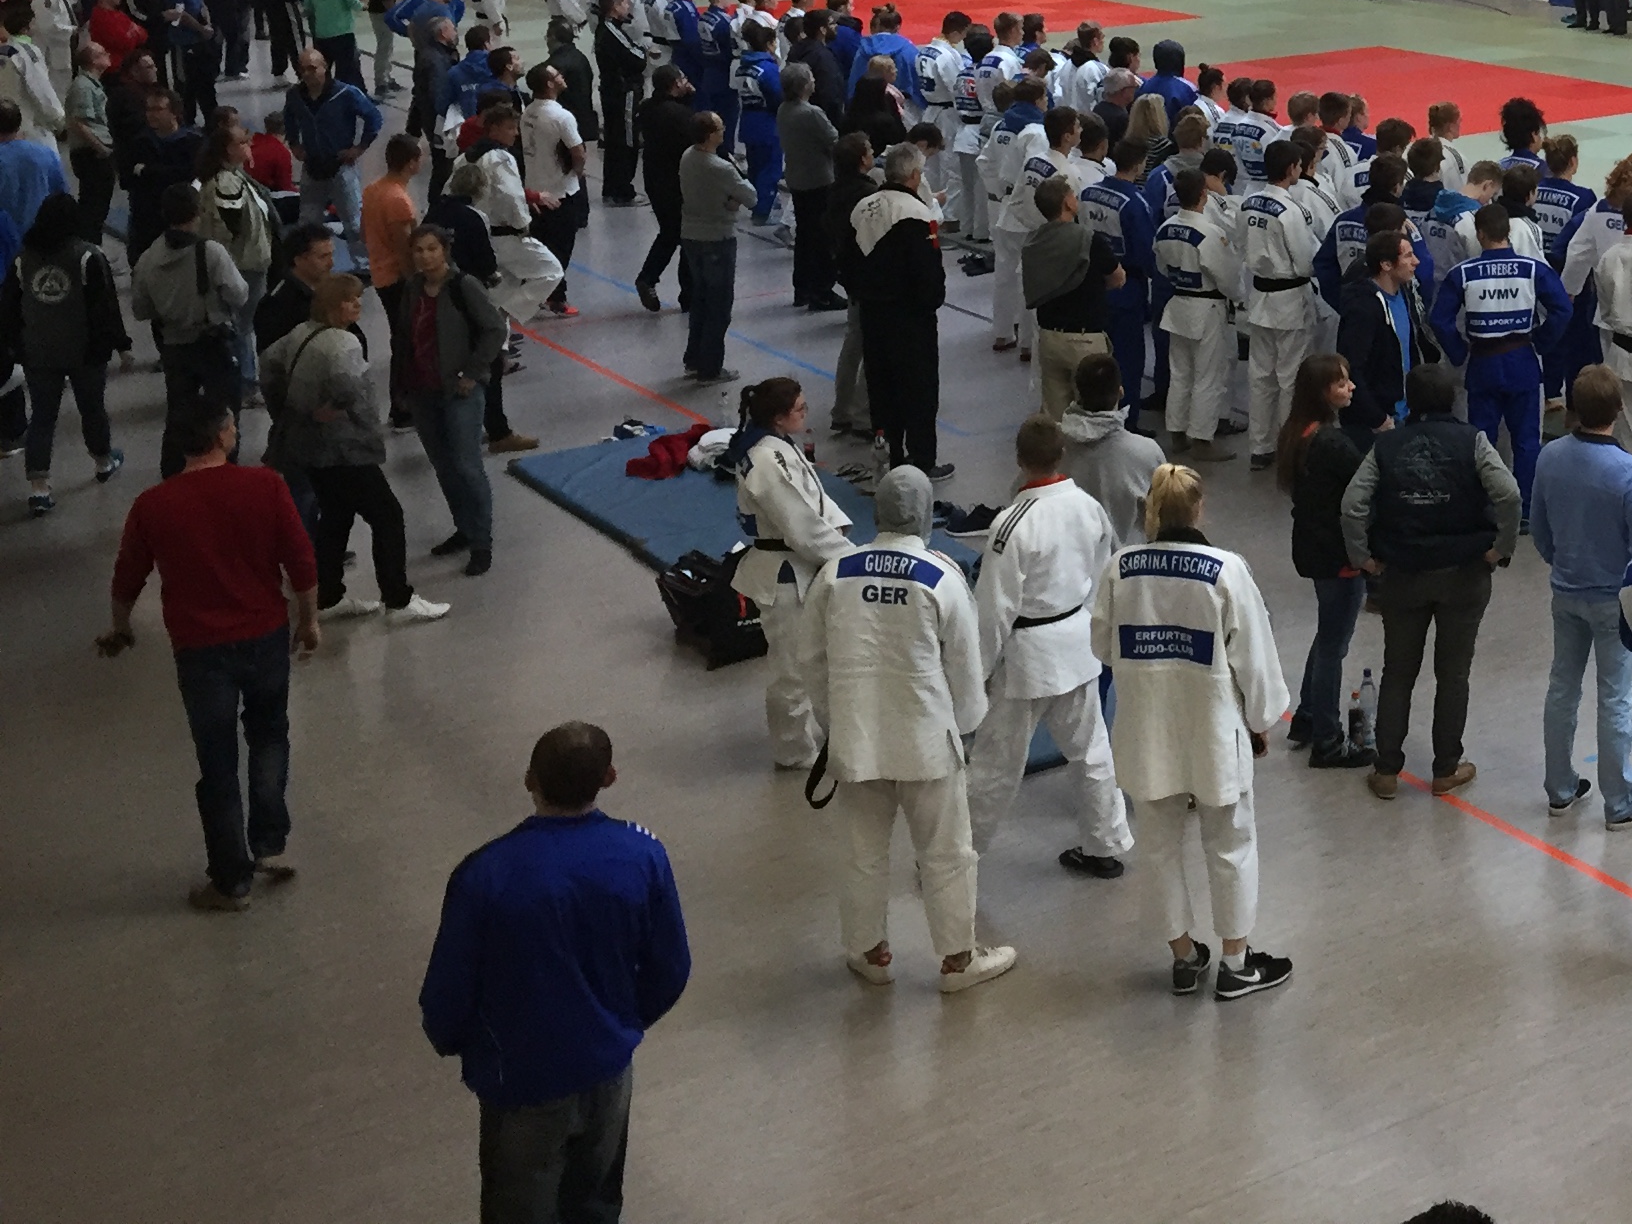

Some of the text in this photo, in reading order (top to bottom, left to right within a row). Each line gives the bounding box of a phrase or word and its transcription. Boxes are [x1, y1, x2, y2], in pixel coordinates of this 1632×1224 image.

[1605, 217, 1626, 231] GE
[1478, 287, 1519, 301] JVMV
[864, 554, 919, 576] GUBERT
[1120, 553, 1221, 579] SABRINA FISCHER
[861, 584, 909, 606] GER
[1134, 630, 1193, 644] ERFURTER
[1132, 643, 1194, 657] JUDO-CLUB
